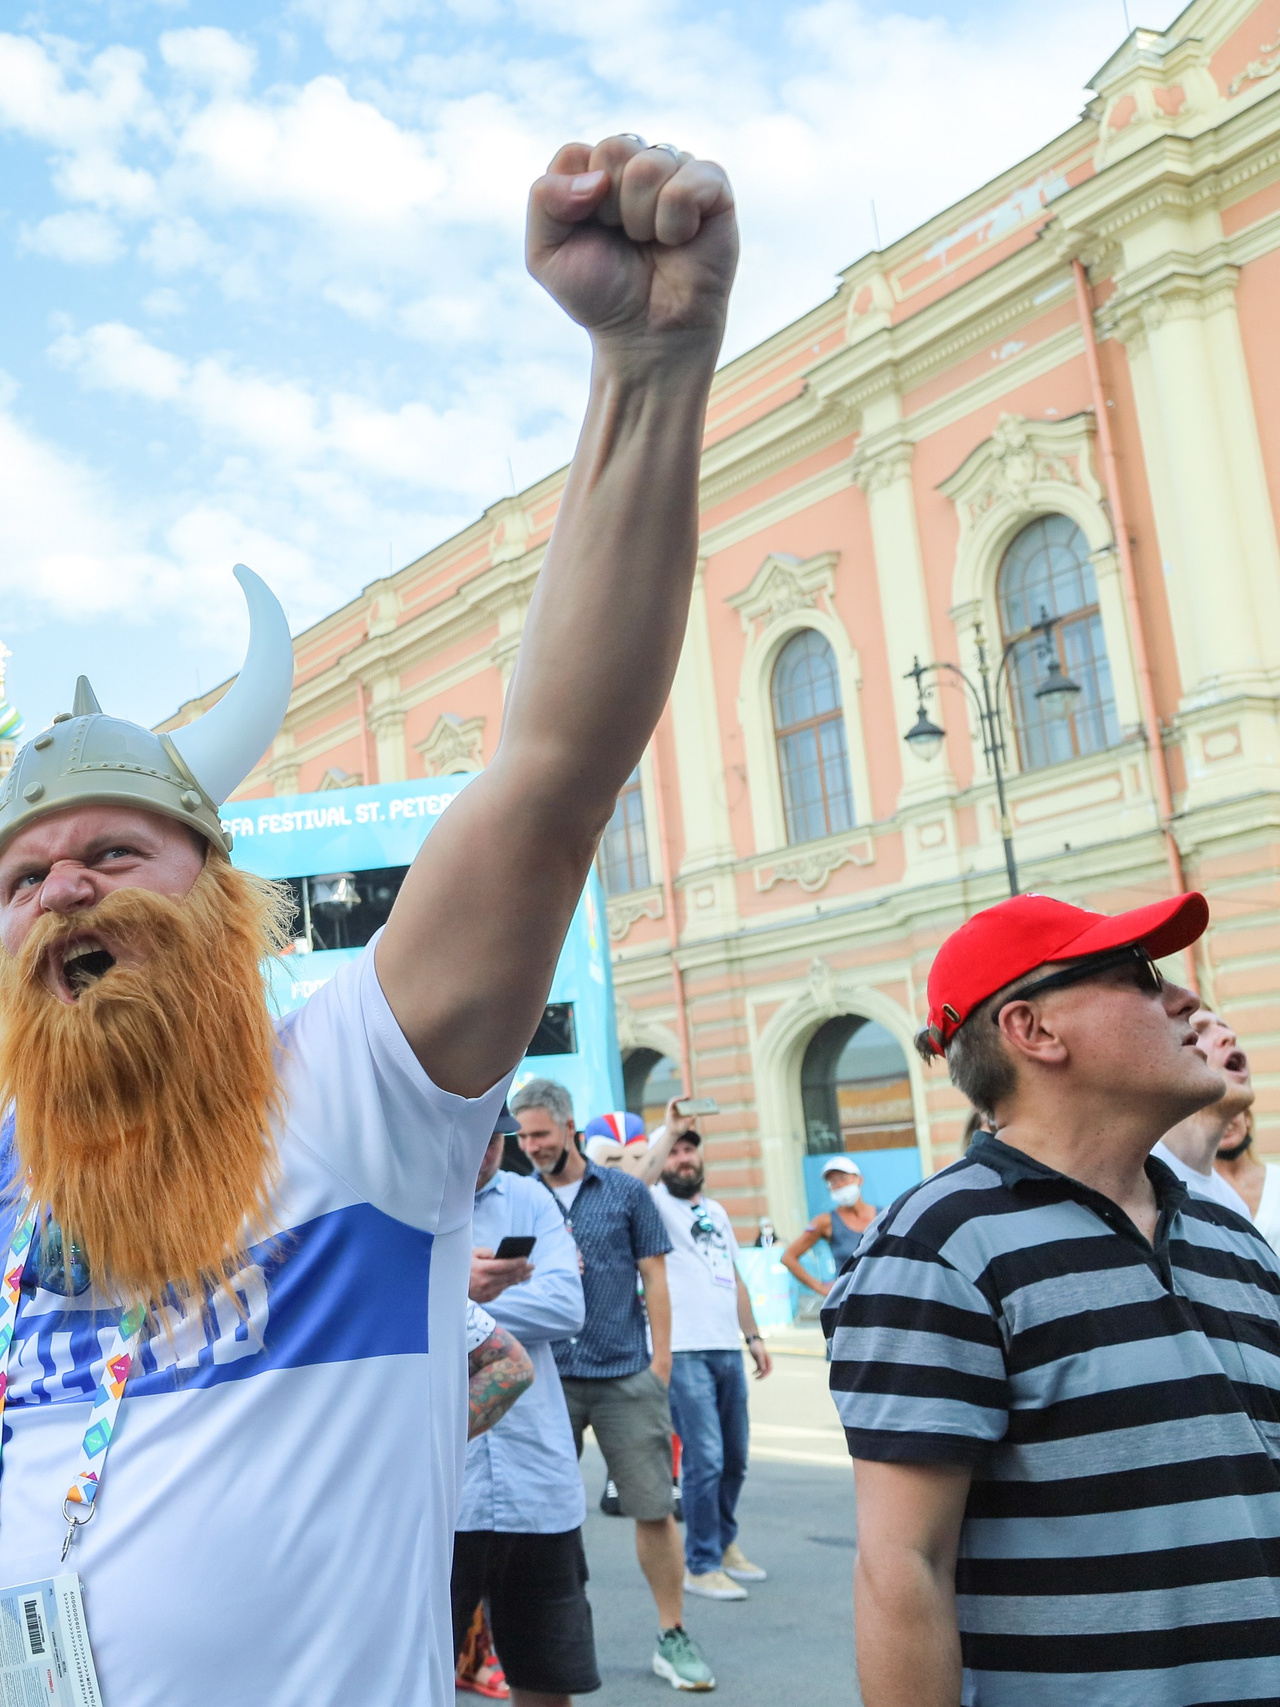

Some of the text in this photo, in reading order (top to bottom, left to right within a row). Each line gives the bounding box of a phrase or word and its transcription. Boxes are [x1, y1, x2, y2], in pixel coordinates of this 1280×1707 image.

[258, 806, 352, 836] FESTIVAL
[355, 801, 386, 824] ST.
[389, 789, 462, 820] PETER
